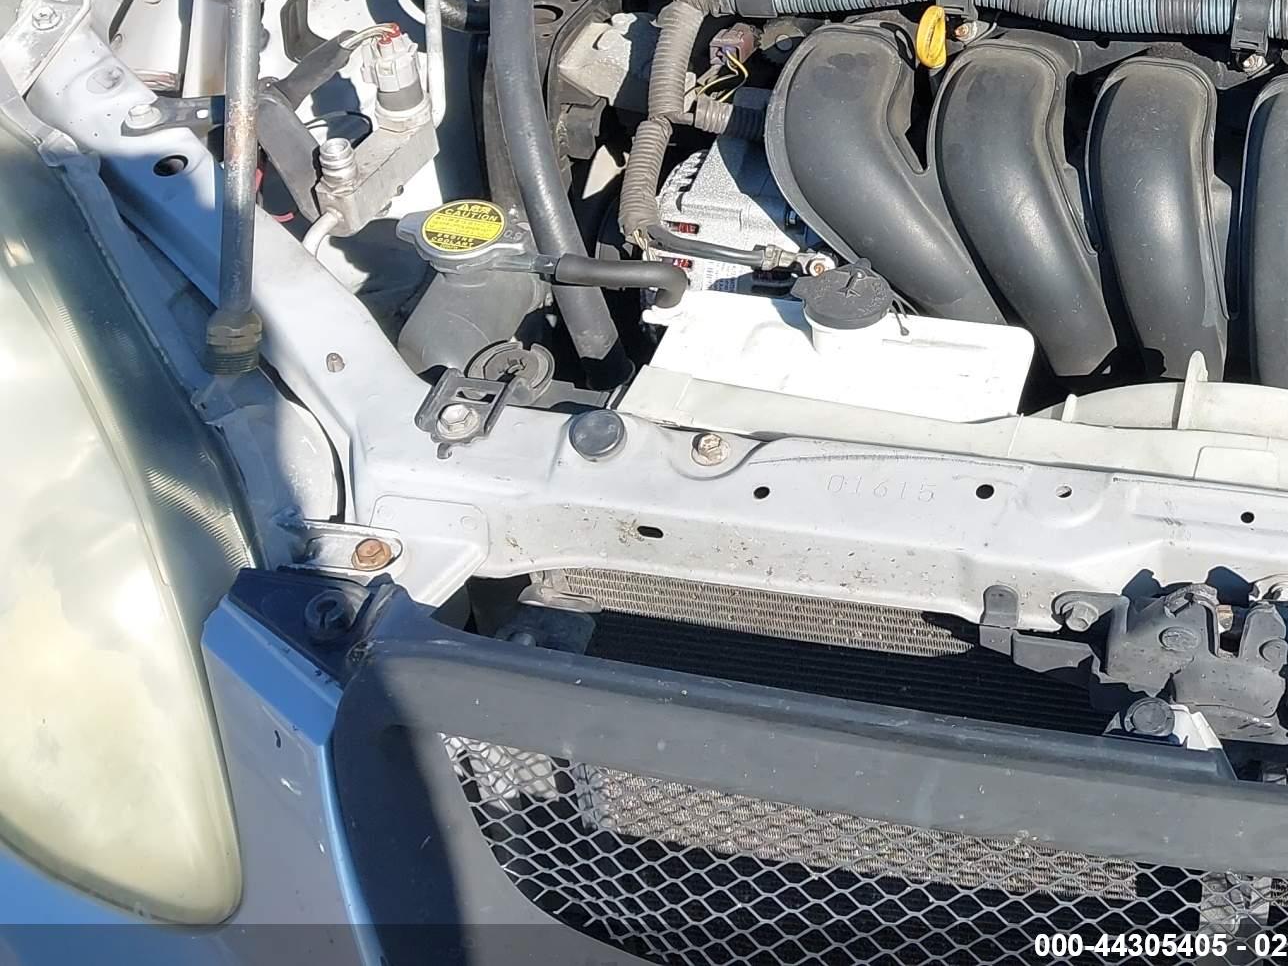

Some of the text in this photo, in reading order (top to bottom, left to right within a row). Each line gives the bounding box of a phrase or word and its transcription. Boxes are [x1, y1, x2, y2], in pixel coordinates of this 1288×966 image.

[444, 208, 499, 222] CAUTION
[431, 236, 475, 248] COOLANT
[437, 233, 474, 243] ENGINE
